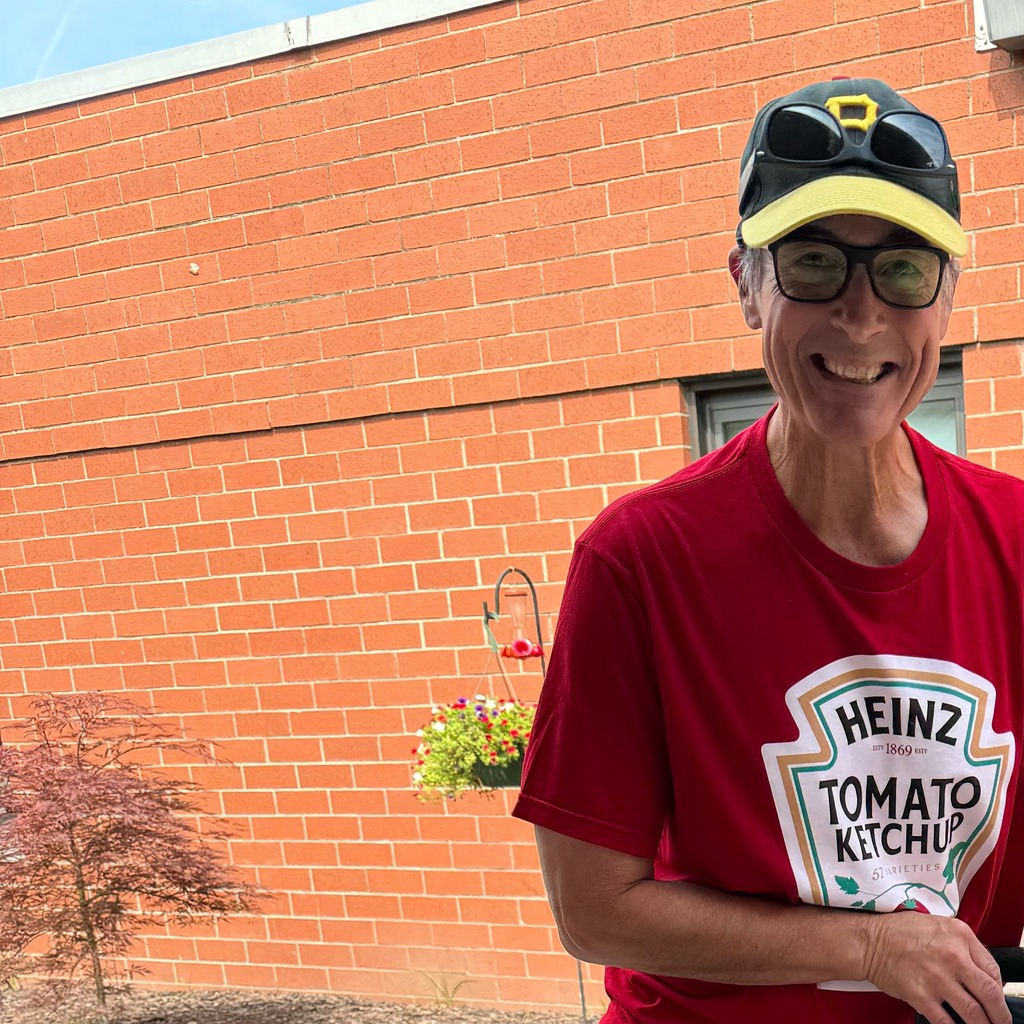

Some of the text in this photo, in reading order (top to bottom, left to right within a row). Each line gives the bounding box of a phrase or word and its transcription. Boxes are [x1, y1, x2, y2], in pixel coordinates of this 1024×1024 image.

[835, 696, 962, 746] HEINZ
[886, 742, 913, 756] 1869
[819, 775, 981, 825] TOMATO
[836, 812, 964, 862] KETCHUP
[872, 867, 884, 880] 57
